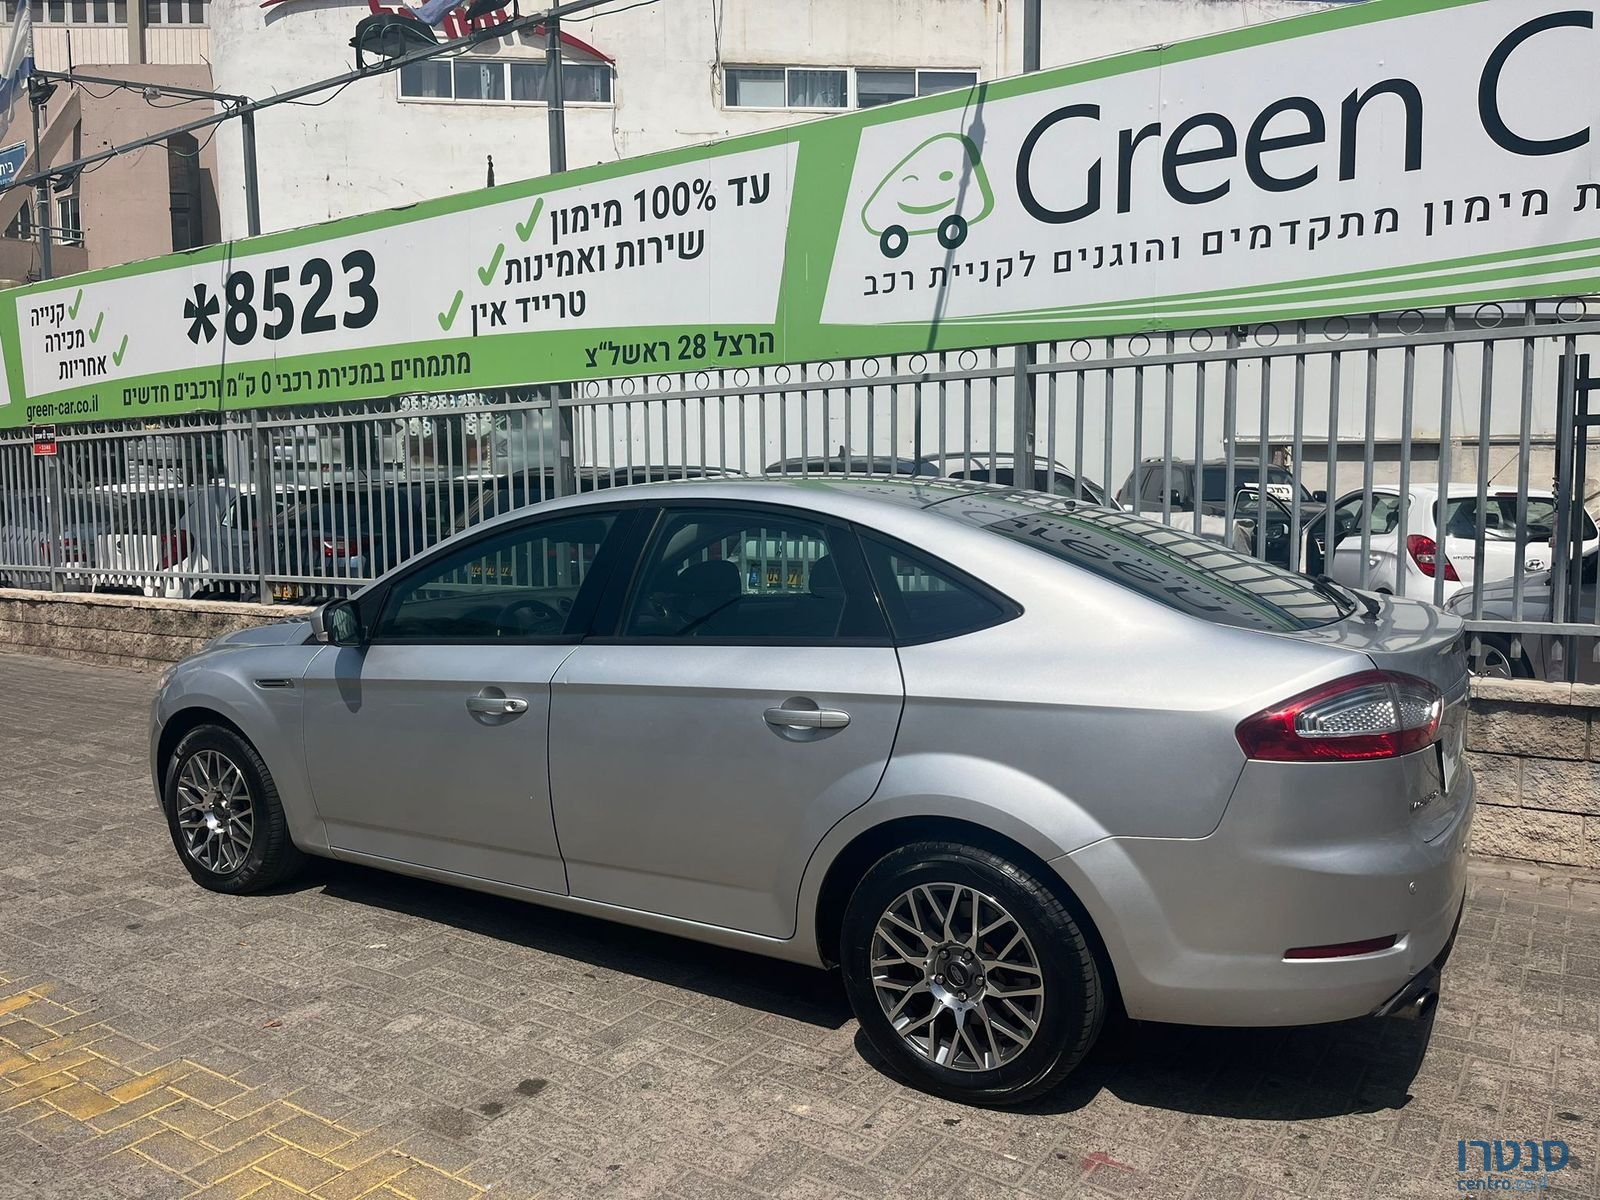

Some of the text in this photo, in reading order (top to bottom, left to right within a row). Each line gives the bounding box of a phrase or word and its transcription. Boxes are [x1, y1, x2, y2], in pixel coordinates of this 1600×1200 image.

[1016, 77, 1422, 224] Green
[551, 173, 769, 245] עד 100% מימון
[1424, 190, 1547, 236] מימון
[1203, 208, 1398, 255] מתקדמים
[505, 230, 704, 285] שירות ואמינות
[1054, 237, 1179, 273] והוגנים
[864, 271, 913, 295] רכב
[929, 251, 1035, 292] לקניית
[32, 304, 64, 328] קנייה
[471, 290, 585, 337] טרייד אין
[46, 329, 84, 352] מכירה
[678, 334, 706, 360] 28
[714, 331, 773, 356] הרצל
[60, 356, 106, 380] אחריות
[318, 363, 384, 389] במכירת
[392, 352, 470, 380] מתמחים
[175, 378, 222, 401] ורכבים
[276, 371, 311, 392] רכבי
[123, 385, 169, 405] חדשים
[27, 396, 99, 422] green-car.co.il
